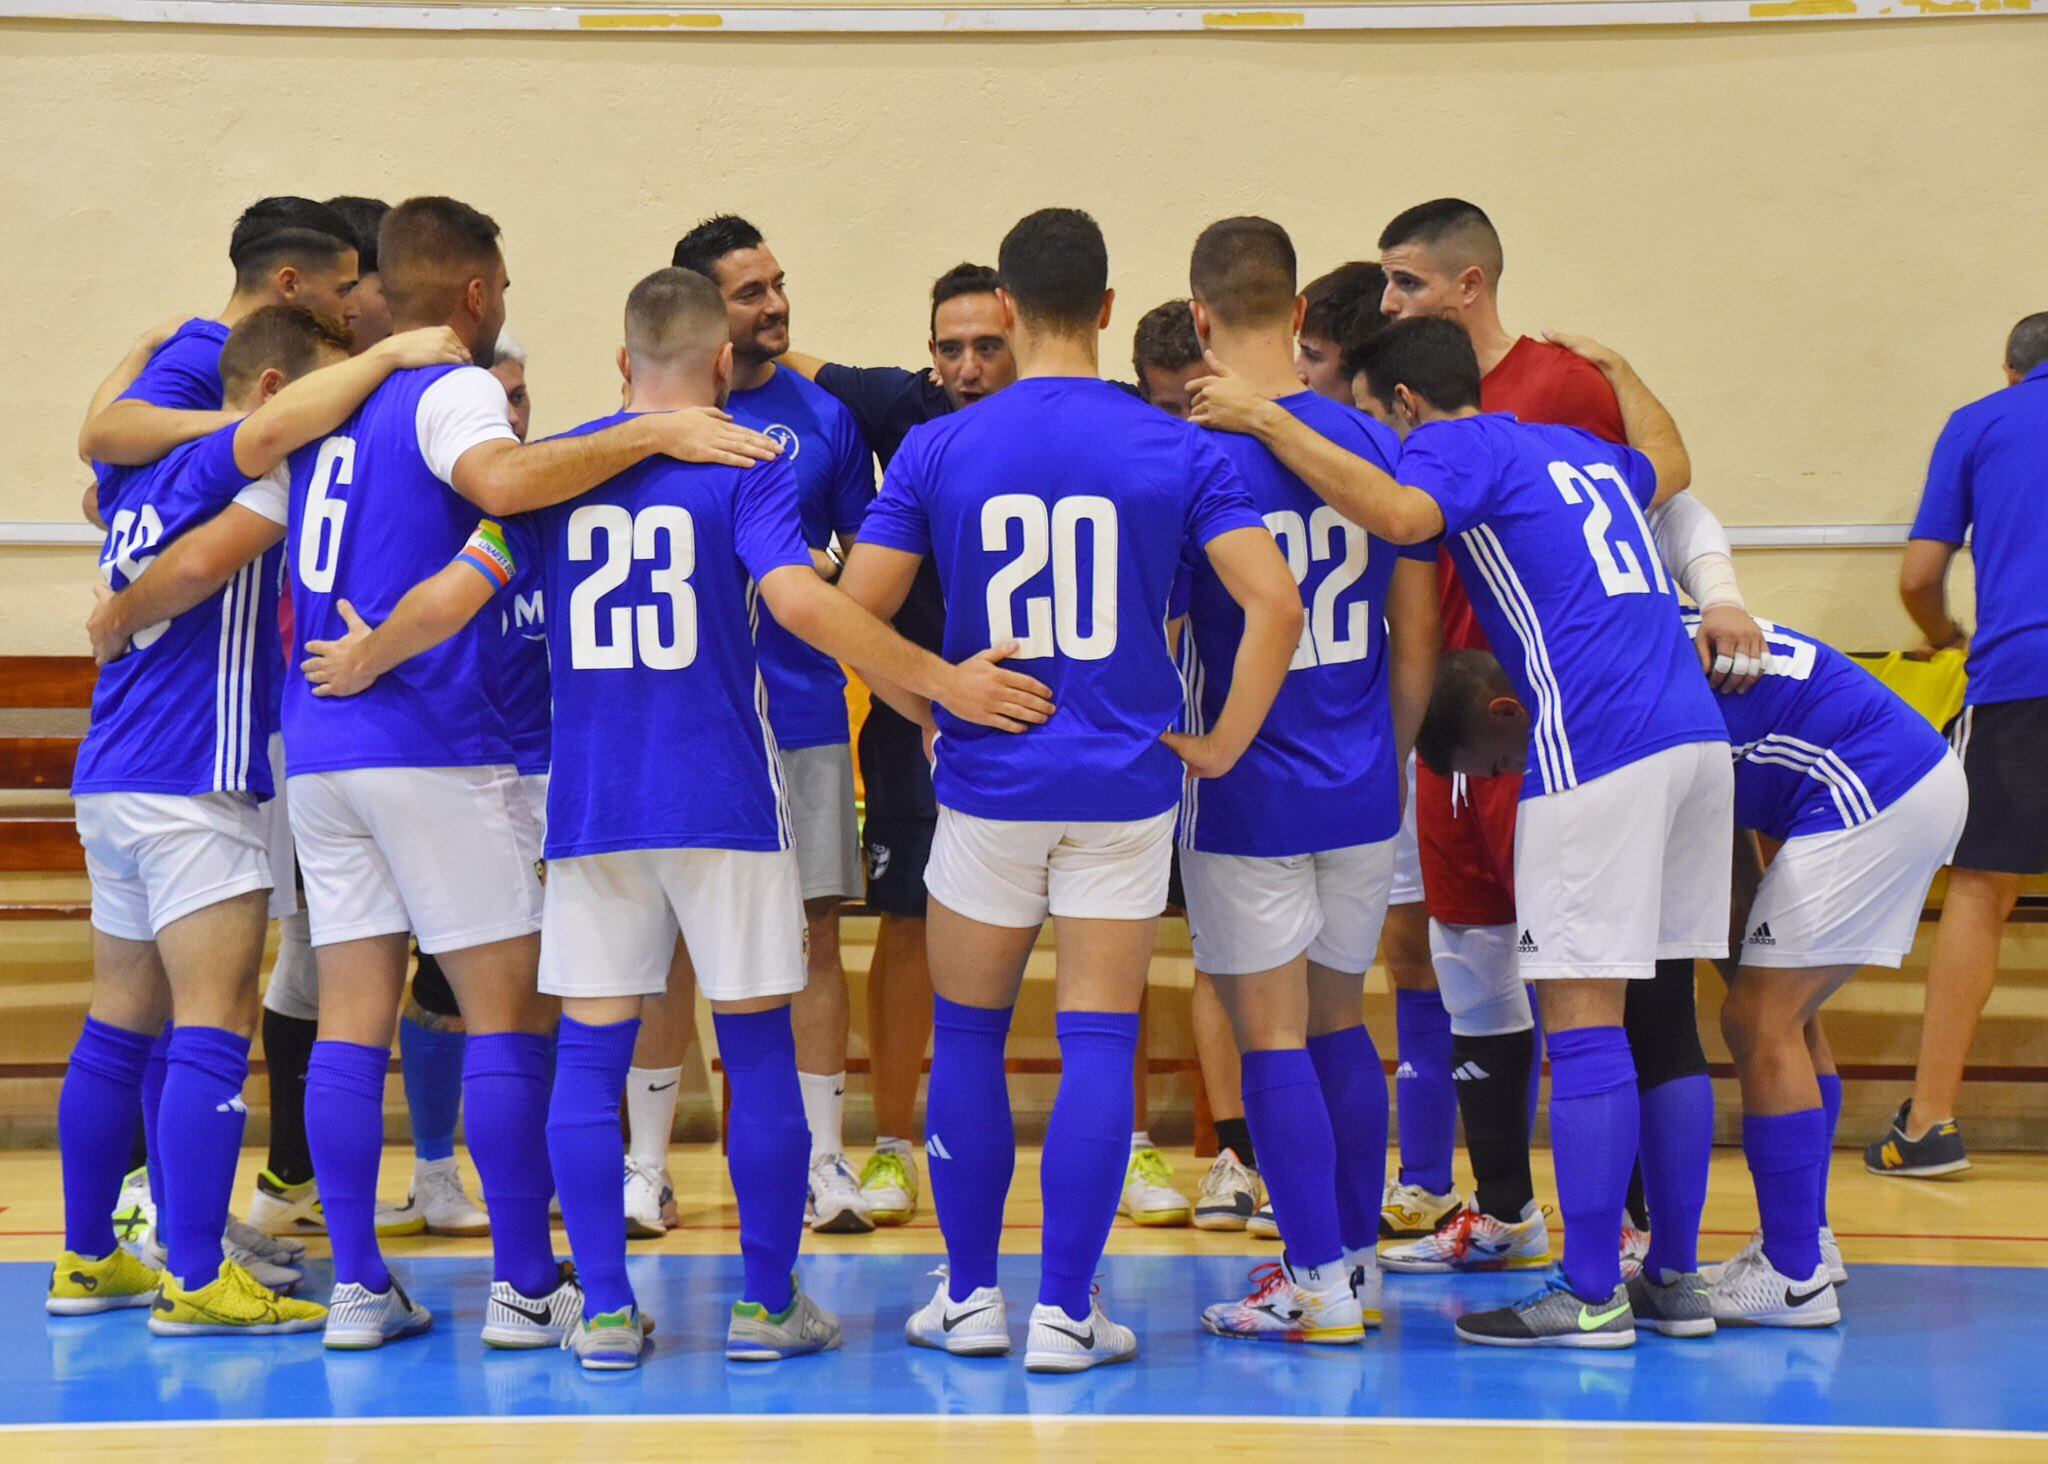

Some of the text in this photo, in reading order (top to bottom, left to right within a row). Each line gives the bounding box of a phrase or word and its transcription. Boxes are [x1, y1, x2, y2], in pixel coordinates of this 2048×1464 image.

[299, 436, 356, 593] 6
[568, 504, 698, 671] 23
[980, 494, 1118, 660] 20
[1548, 461, 1670, 597] 27
